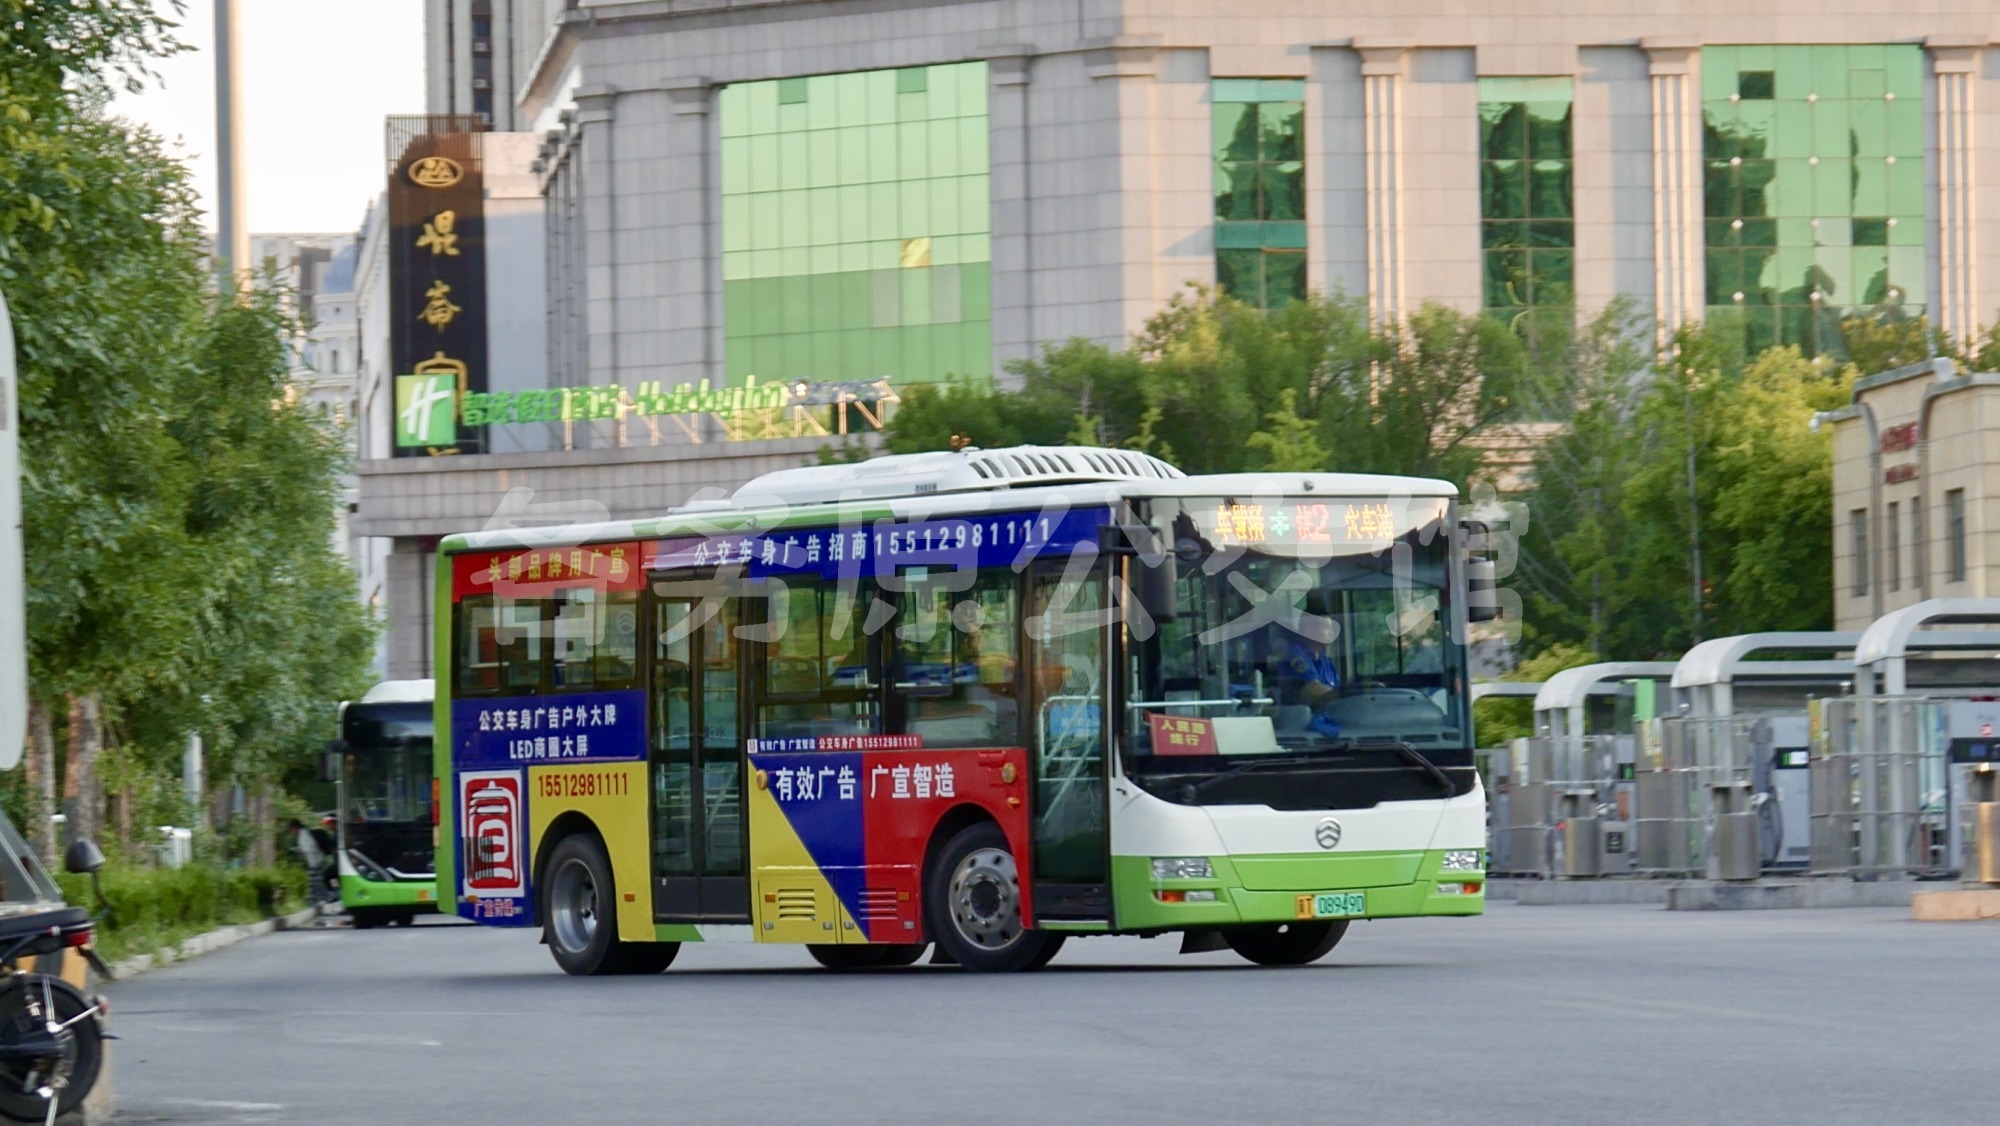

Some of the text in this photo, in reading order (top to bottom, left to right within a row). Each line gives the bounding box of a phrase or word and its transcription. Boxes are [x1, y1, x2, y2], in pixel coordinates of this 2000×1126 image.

[694, 517, 1050, 566] 公交车身广告招商15512981111
[489, 547, 626, 583] 头部品牌用广宣
[478, 703, 618, 731] 公交车身广告户外大牌
[509, 734, 589, 760] LED商圈大屏
[818, 736, 919, 750] 公交车身广告15512981111
[537, 772, 629, 798] 15512981111
[775, 762, 956, 801] 有效广告 广宣智造
